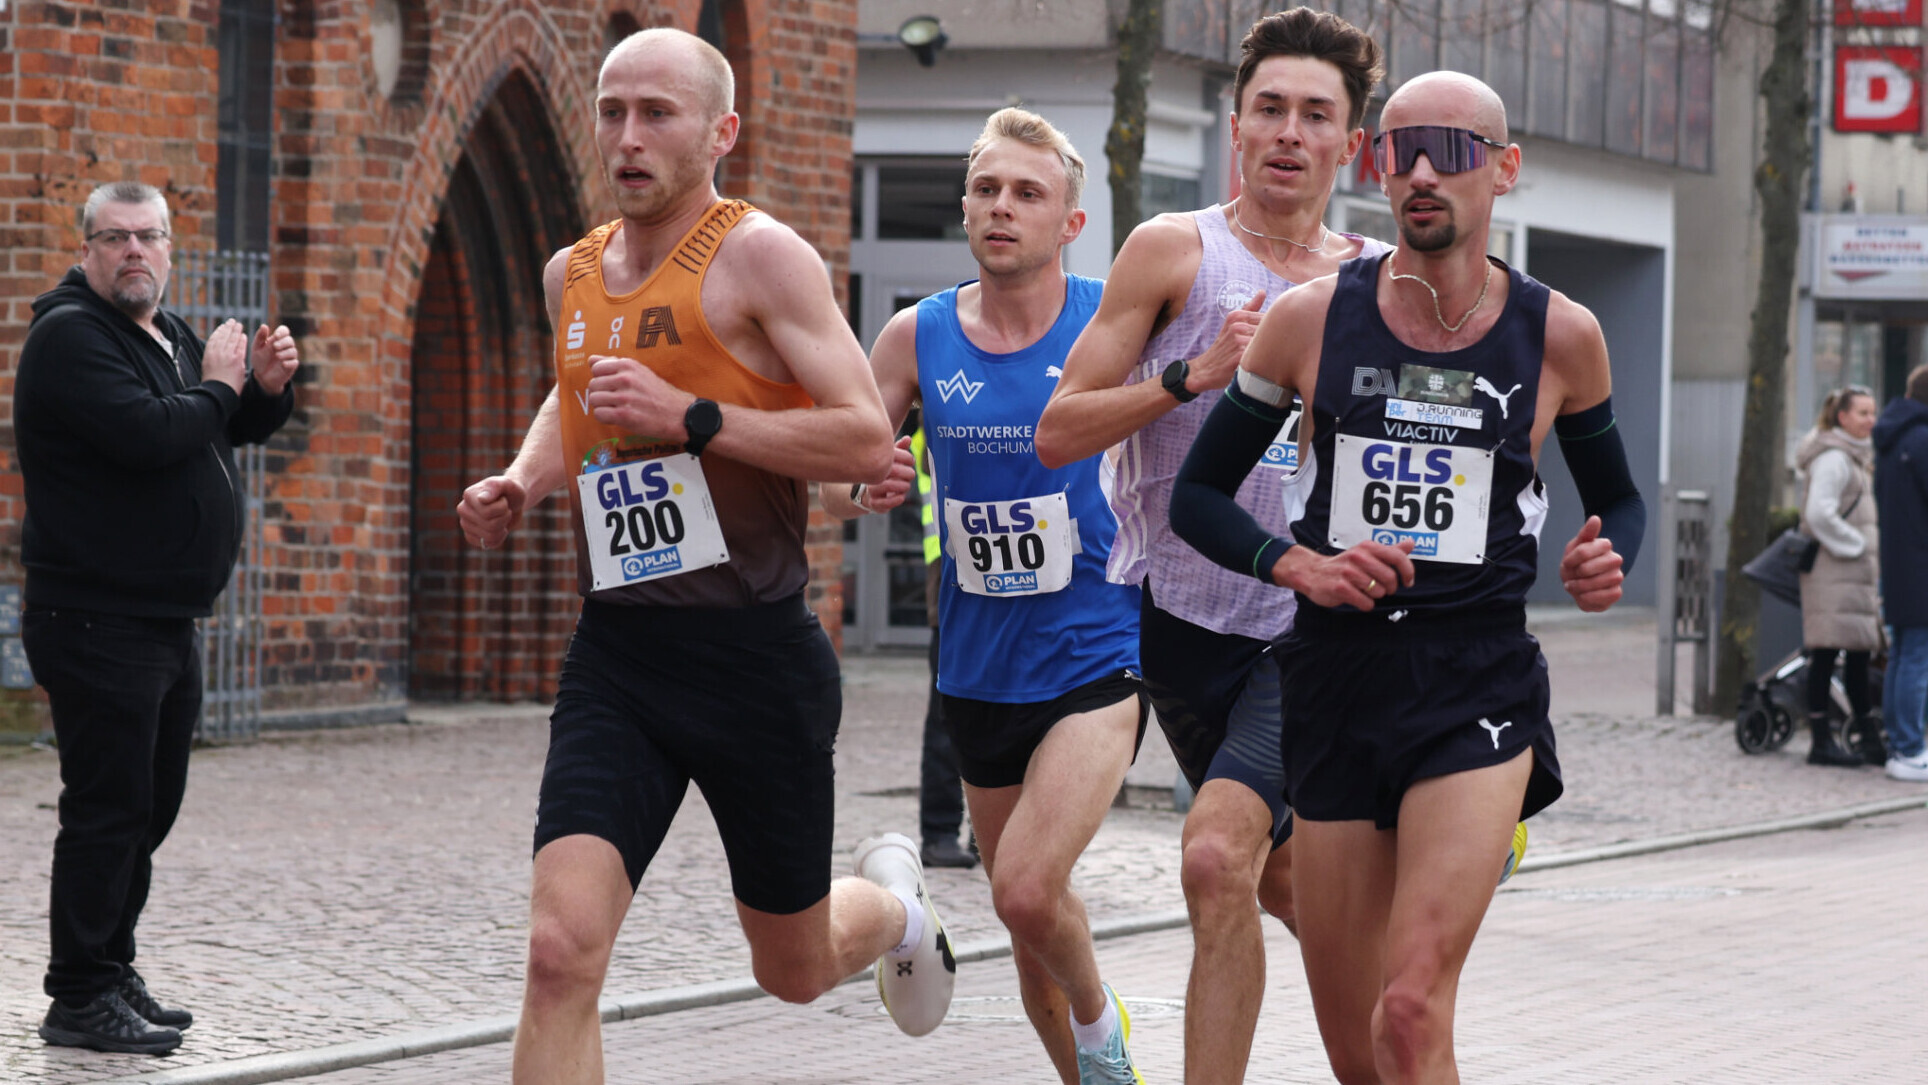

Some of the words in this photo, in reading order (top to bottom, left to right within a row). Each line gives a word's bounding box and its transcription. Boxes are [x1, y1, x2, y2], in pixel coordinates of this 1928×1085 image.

[1844, 60, 1913, 119] D
[1416, 412, 1453, 425] TEAM
[937, 425, 1032, 438] STADTWERKE
[1383, 421, 1459, 443] VIACTIV
[968, 442, 1033, 454] BOCHUM
[1362, 481, 1454, 531] 656
[605, 500, 685, 557] 200
[643, 550, 678, 568] PLAN
[968, 533, 1045, 572] 910
[1004, 575, 1035, 586] PLAN
